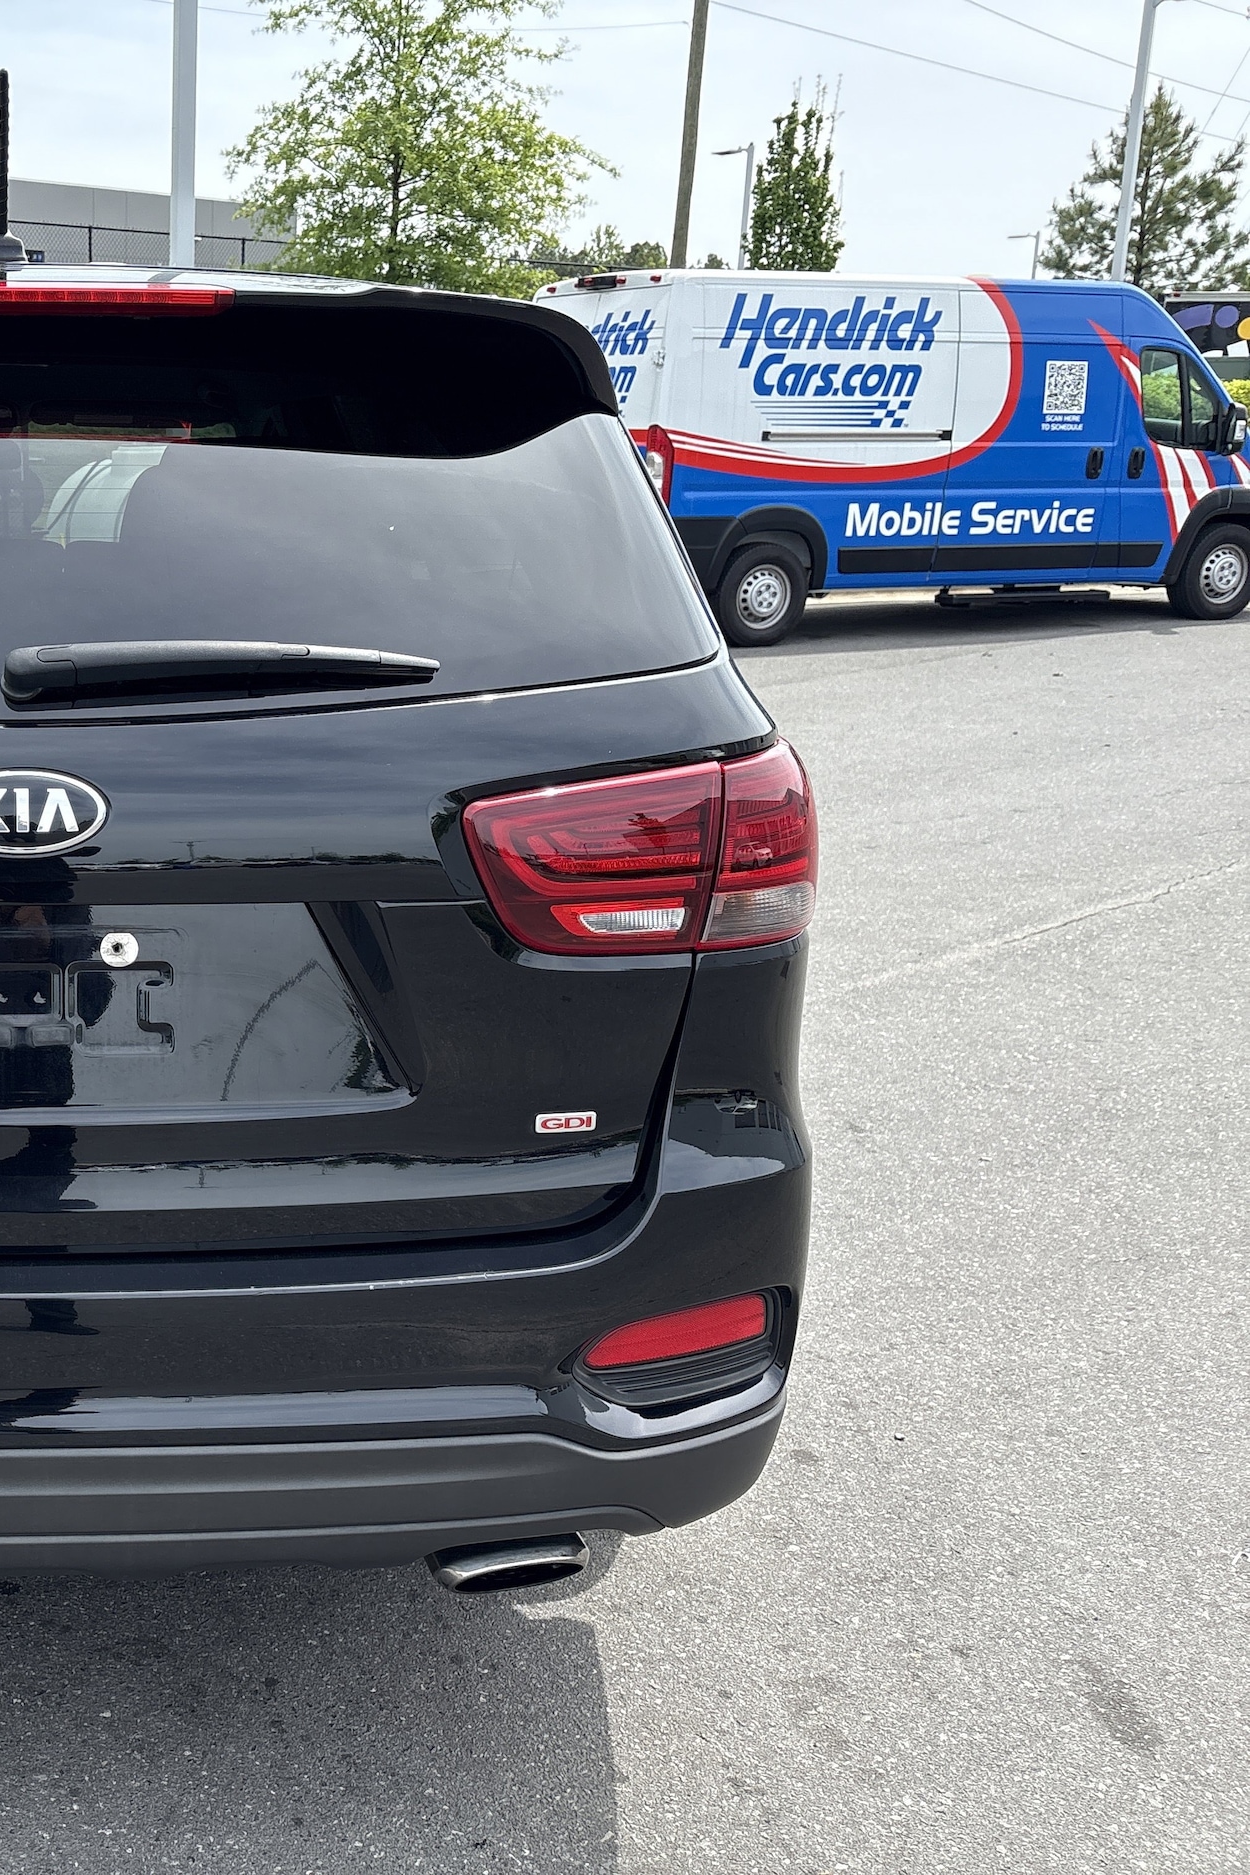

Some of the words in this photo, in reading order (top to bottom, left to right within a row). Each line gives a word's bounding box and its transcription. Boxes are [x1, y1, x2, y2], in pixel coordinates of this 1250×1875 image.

[590, 309, 656, 356] drick
[718, 292, 943, 369] Hendrick
[753, 353, 922, 397] Cars.com
[1041, 423, 1050, 431] TO
[1050, 423, 1084, 431] SCHEDULE
[844, 502, 962, 537] Mobile
[969, 500, 1096, 535] Service
[540, 1116, 592, 1130] GDI
